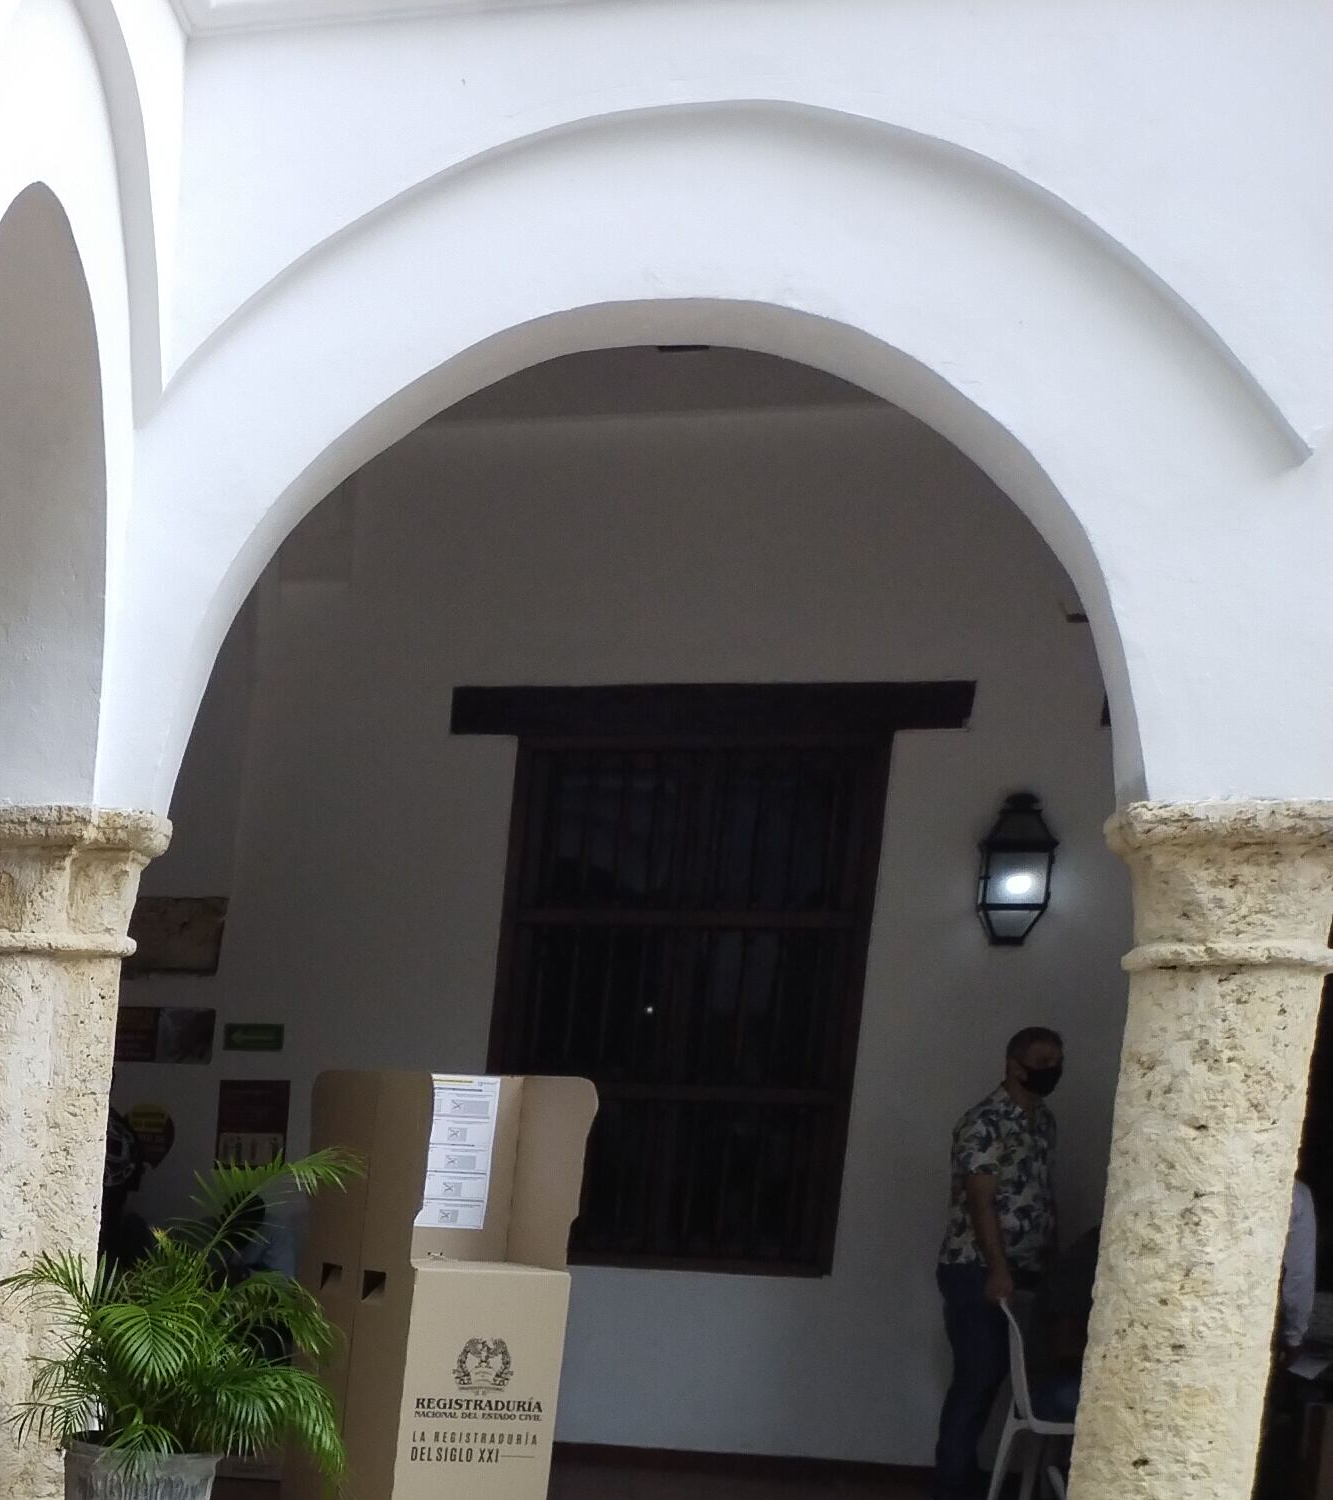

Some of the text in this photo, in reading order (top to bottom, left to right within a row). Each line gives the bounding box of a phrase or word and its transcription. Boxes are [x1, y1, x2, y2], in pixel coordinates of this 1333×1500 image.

[415, 1396, 543, 1412] REGISTRADURÍA
[413, 1431, 425, 1442] LA
[411, 1447, 499, 1463] DEL SIGLO XXI
